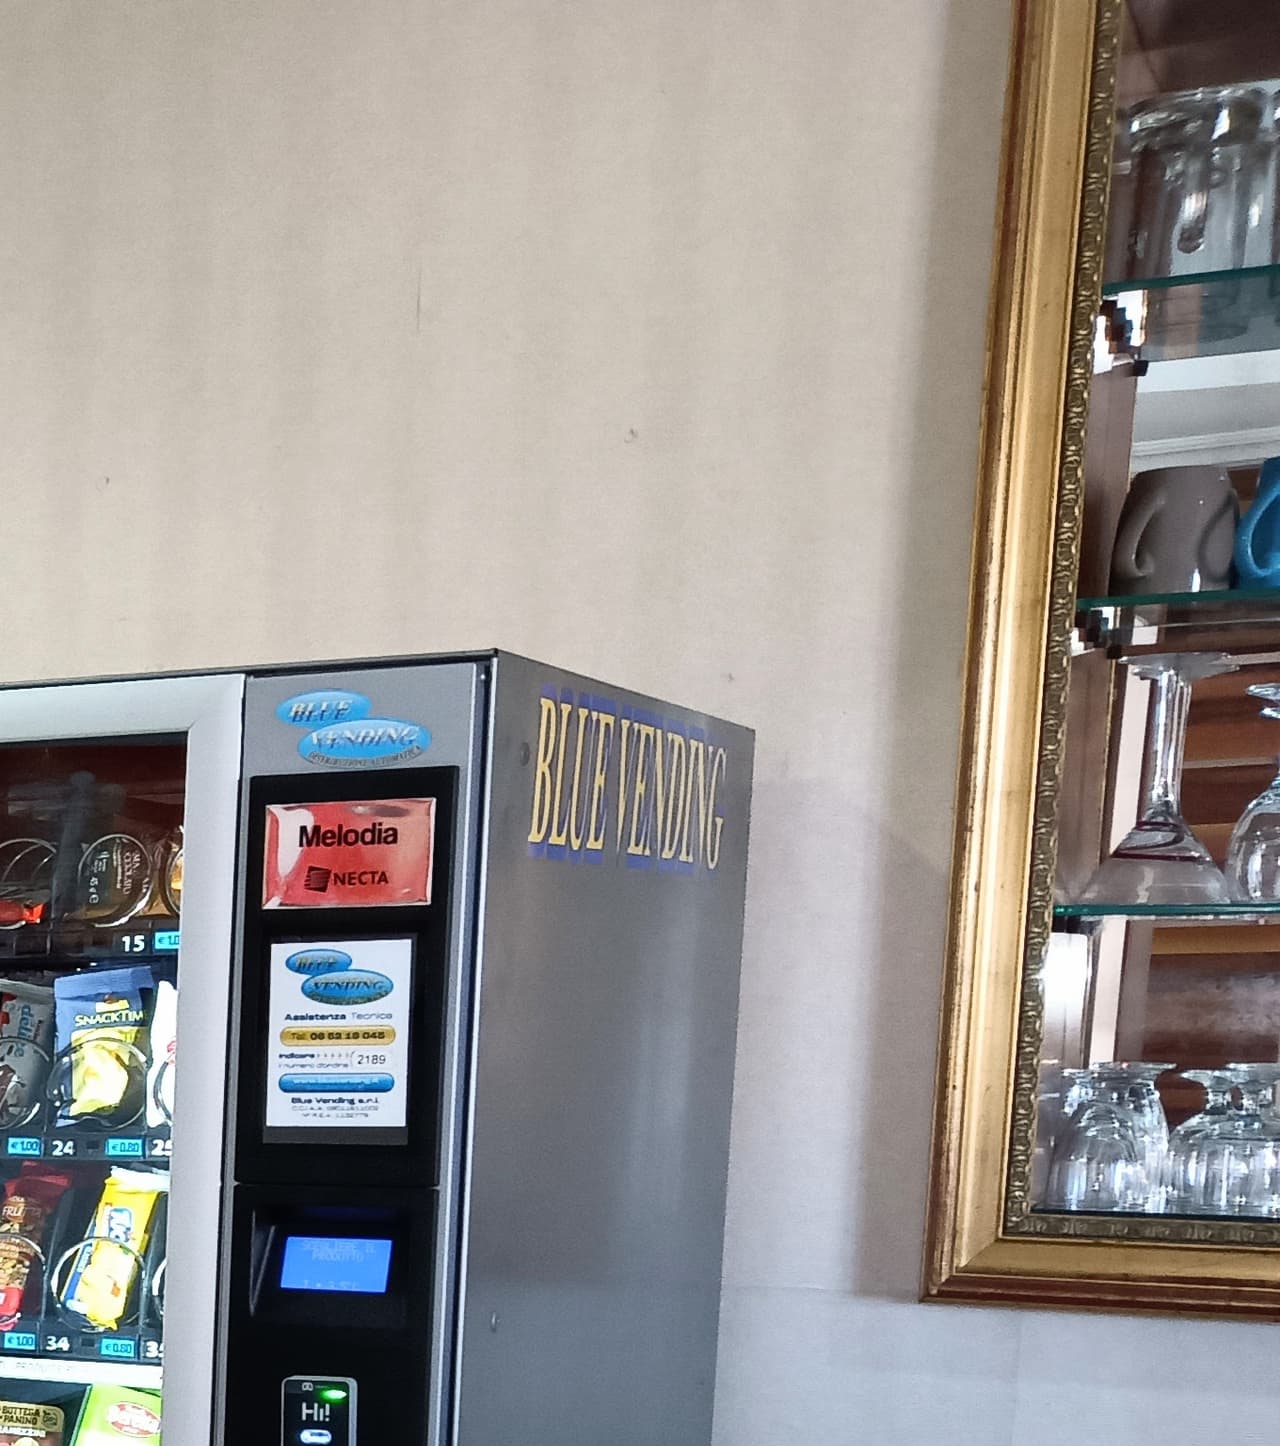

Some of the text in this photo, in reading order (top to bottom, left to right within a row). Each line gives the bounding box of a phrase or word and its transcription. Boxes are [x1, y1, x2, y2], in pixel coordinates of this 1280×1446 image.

[527, 696, 728, 871] BLUE VENDING
[298, 822, 399, 848] Melodia
[333, 870, 389, 886] NECTA
[121, 935, 145, 952] 15
[284, 1011, 393, 1021] Assistenza Tecnica
[357, 1054, 387, 1066] 2189
[291, 1097, 313, 1105] Blue
[315, 1097, 356, 1106] Vending
[51, 1140, 75, 1157] 24
[46, 1336, 70, 1352] 34
[2, 1405, 41, 1419] BOTTEGA
[3, 1415, 38, 1427] PANINO
